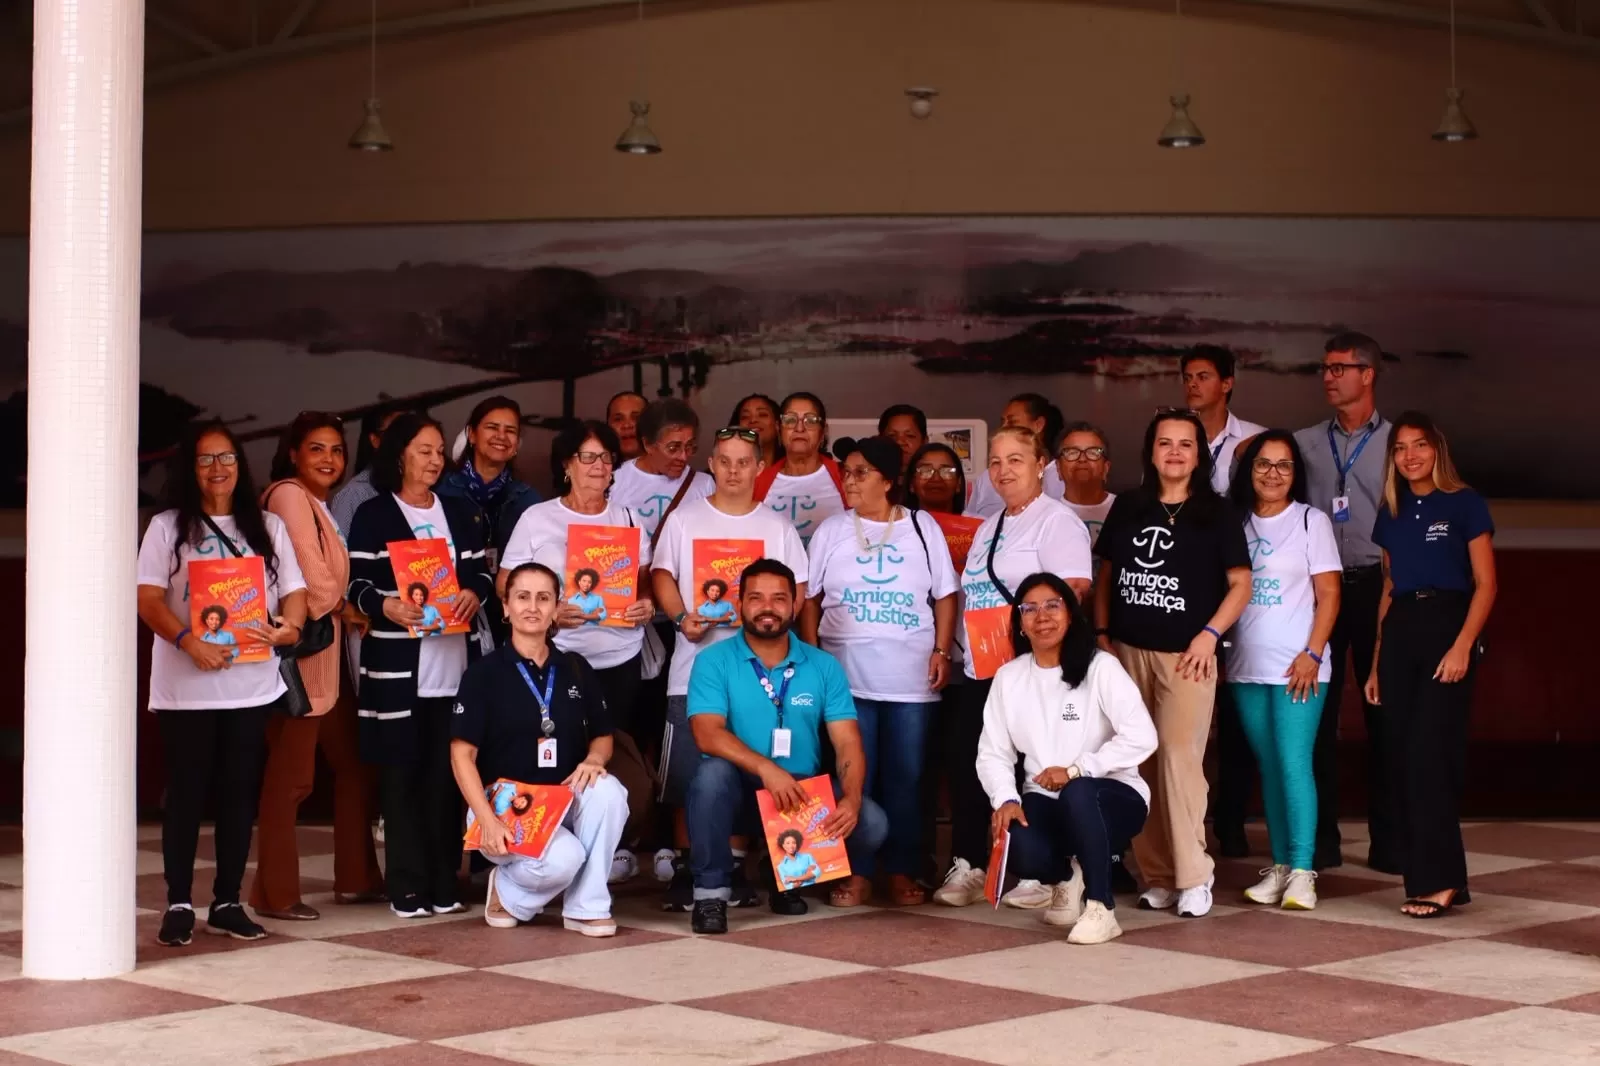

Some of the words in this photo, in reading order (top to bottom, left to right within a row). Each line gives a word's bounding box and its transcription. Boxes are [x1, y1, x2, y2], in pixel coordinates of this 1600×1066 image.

[944, 533, 973, 546] PROFIS
[1118, 567, 1180, 592] Amigos
[1251, 577, 1280, 593] gos
[840, 586, 915, 609] Amigos
[1120, 587, 1129, 597] da
[1126, 586, 1186, 614] Justiça
[1249, 590, 1282, 609] stiça
[847, 604, 859, 615] da
[855, 604, 920, 631] Justiça
